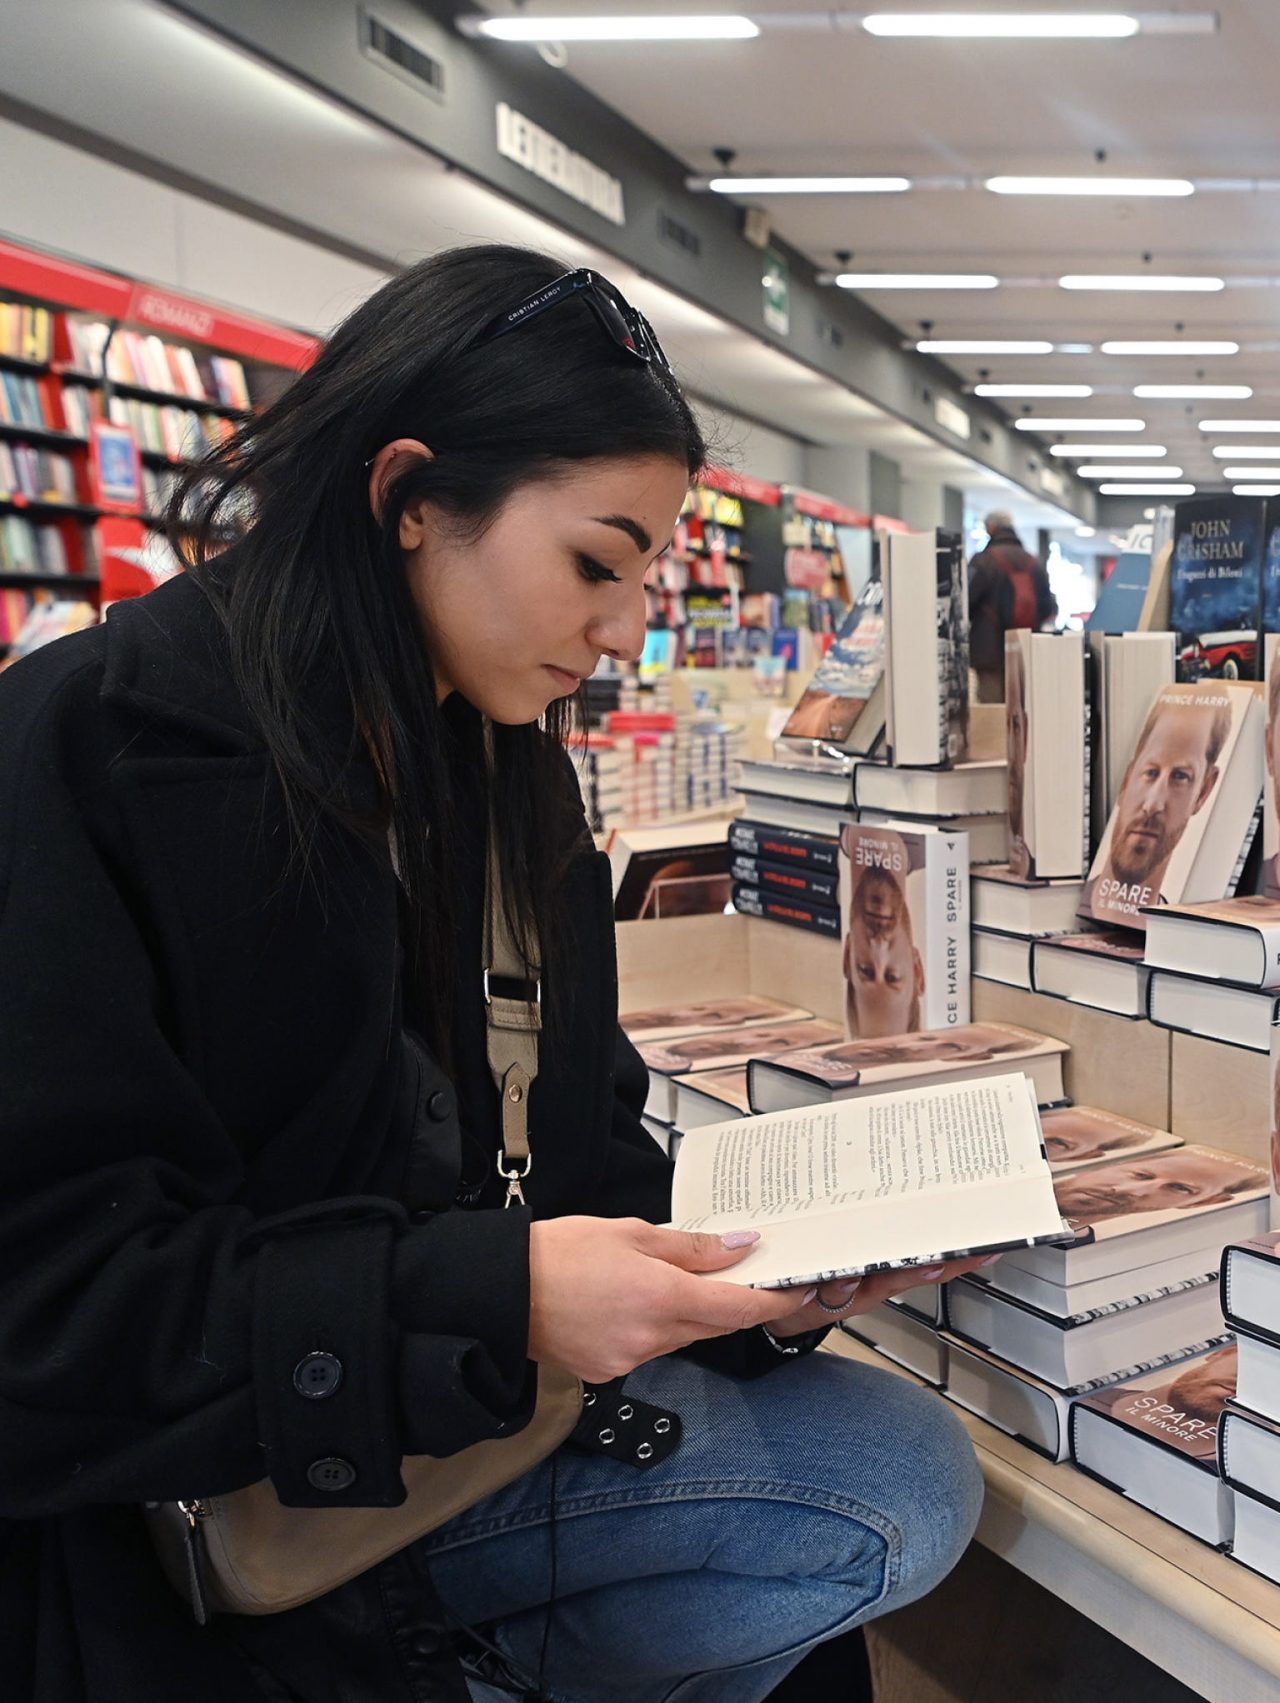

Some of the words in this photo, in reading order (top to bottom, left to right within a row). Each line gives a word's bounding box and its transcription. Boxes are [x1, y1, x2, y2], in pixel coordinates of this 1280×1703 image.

[508, 299, 540, 321] CRISTIAN
[540, 286, 561, 302] LEROY
[1191, 519, 1231, 539] JOHN
[1177, 541, 1244, 561] GRISHAM
[856, 847, 902, 872] SPARE
[946, 867, 958, 923] SPARE
[1099, 879, 1152, 905] SPARE
[946, 937, 958, 995] HARRY
[1124, 1406, 1137, 1416] IL
[1142, 1413, 1197, 1442] MINORE
[1134, 1397, 1217, 1440] SPARE
